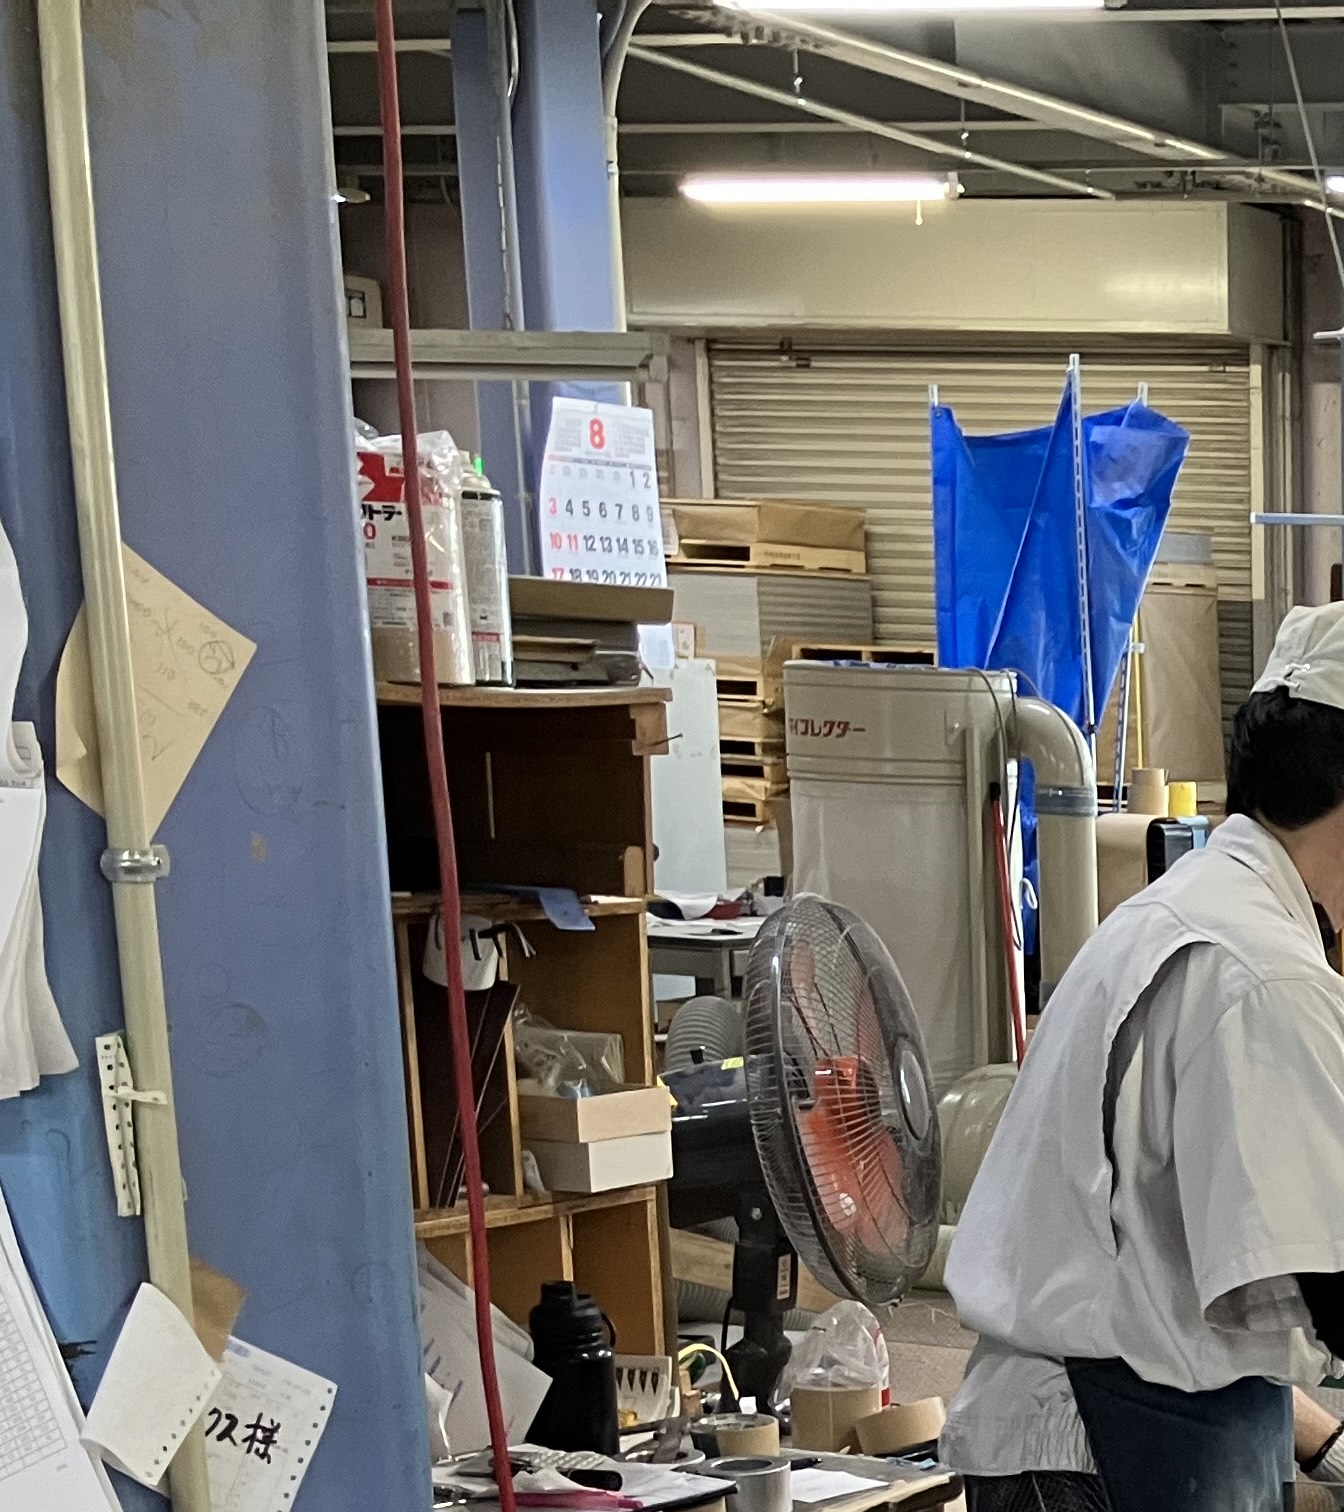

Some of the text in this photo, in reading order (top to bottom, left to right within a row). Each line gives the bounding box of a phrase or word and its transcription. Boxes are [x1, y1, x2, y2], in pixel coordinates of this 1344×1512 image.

[588, 418, 606, 450] 8
[629, 471, 636, 489] 1
[643, 472, 651, 489] 2
[549, 497, 557, 516] 3
[565, 499, 574, 517] 4
[582, 500, 591, 517] 5
[598, 502, 607, 518] 6
[615, 503, 623, 520] 7
[631, 504, 640, 521] 8
[549, 532, 562, 550] 10
[567, 533, 579, 551] 11
[583, 534, 597, 551] 12
[600, 536, 612, 553] 13
[616, 537, 629, 554] 14
[632, 538, 644, 555] 15
